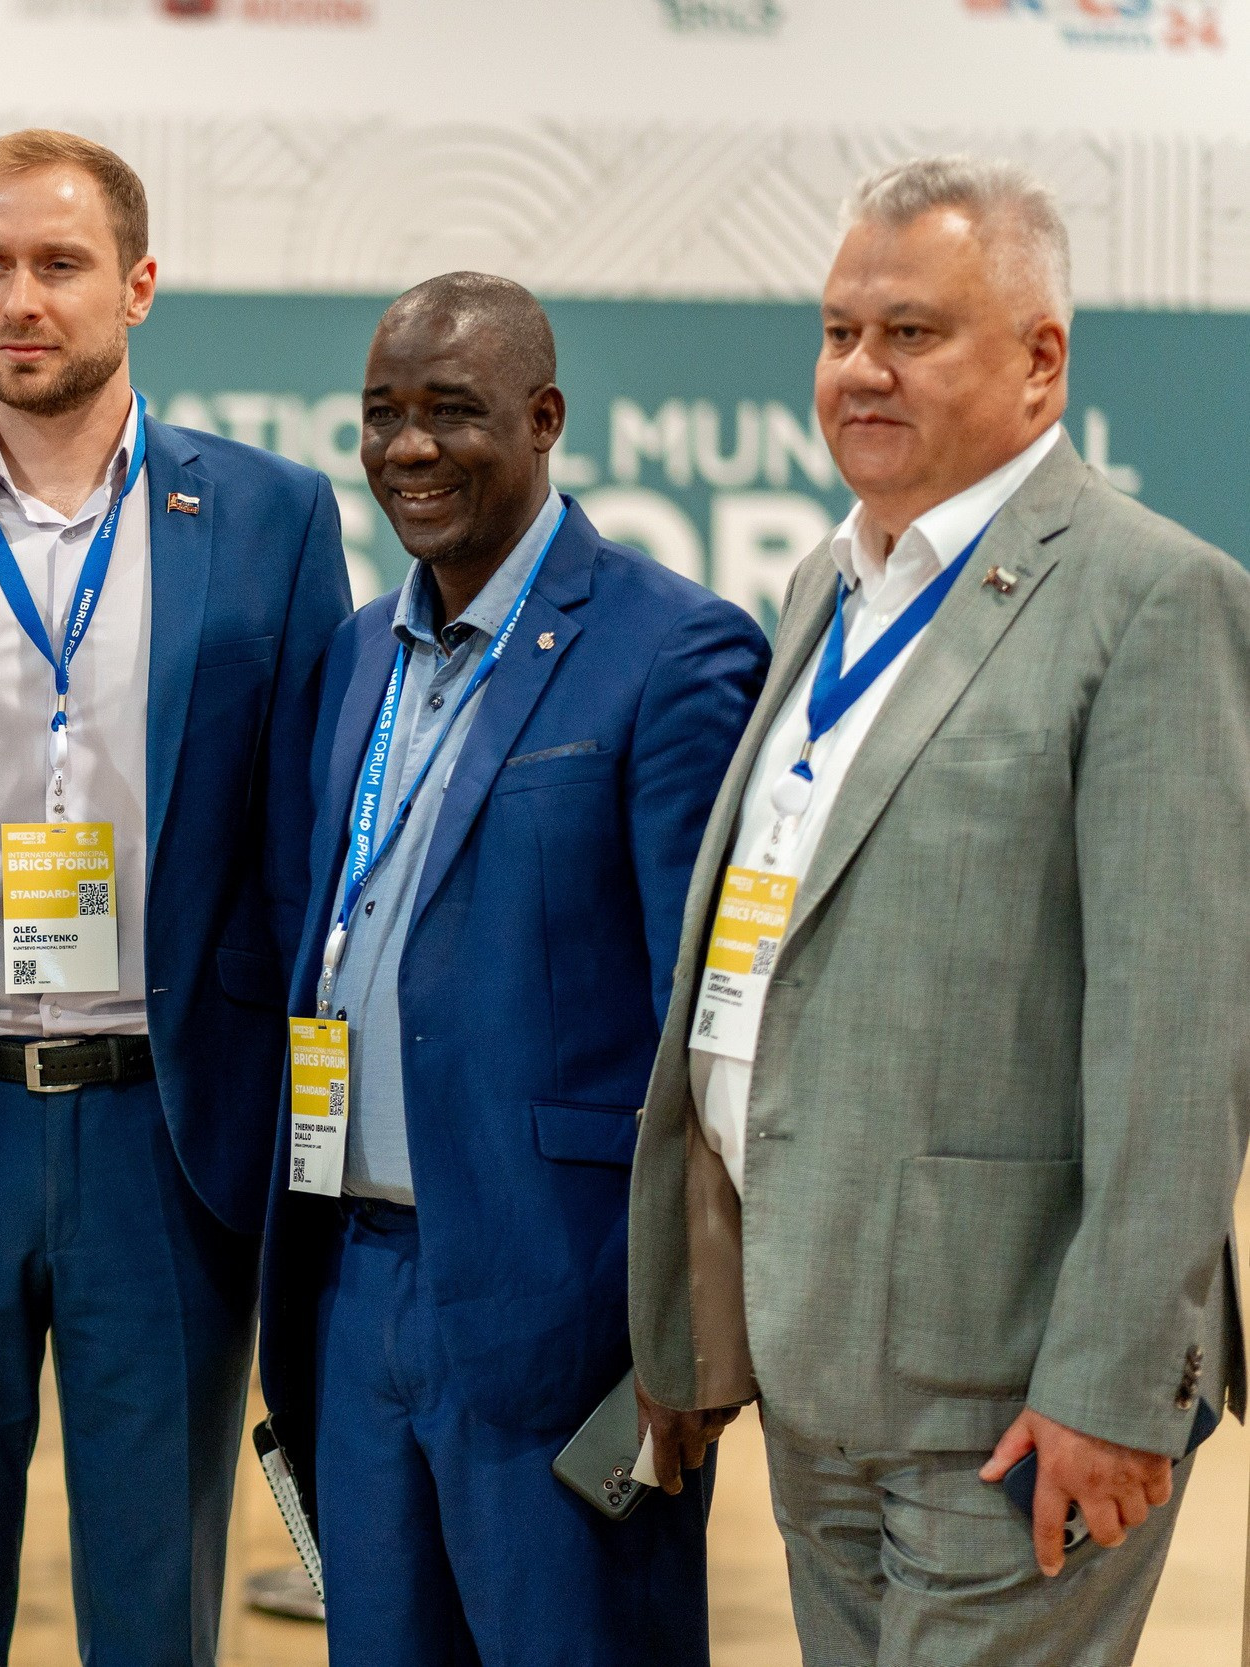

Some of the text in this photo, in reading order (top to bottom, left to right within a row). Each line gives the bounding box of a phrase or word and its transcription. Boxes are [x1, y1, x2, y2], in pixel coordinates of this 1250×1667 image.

[71, 588, 94, 638] IMBRICS
[366, 732, 389, 786] FORUM
[352, 792, 377, 881] ММФ БРИКС
[70, 850, 108, 858] MUNICIPAL
[8, 857, 109, 872] BRICS FORUM
[10, 889, 77, 900] STANDARD+
[13, 926, 37, 934] OLEG
[13, 934, 78, 943] ALEKSEYENKO
[293, 1052, 346, 1069] BRICS FORUM
[295, 1123, 337, 1133] THIERNO IBRAHIMA
[294, 1132, 311, 1140] DIALLO
